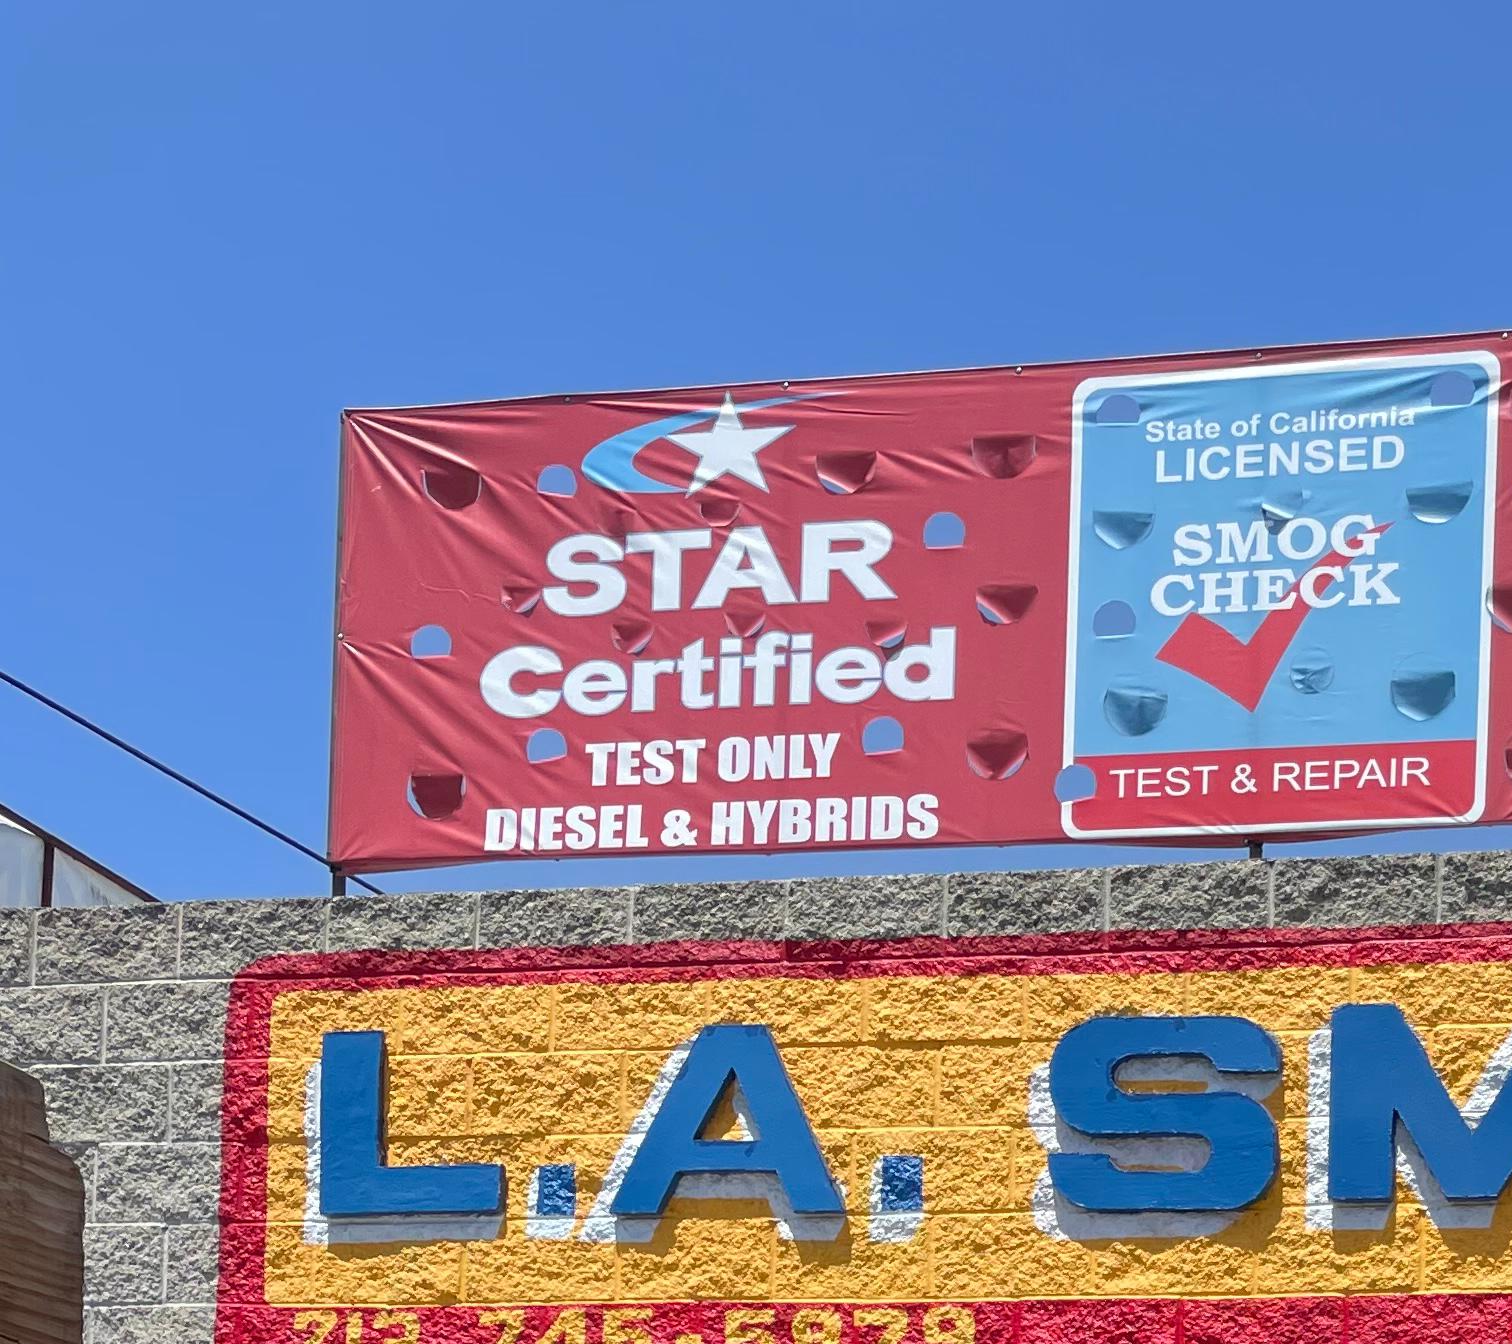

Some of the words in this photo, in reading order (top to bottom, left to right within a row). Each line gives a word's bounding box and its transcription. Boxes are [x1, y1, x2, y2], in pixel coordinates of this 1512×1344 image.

[1144, 418, 1220, 444] State
[1230, 412, 1261, 437] of
[1269, 406, 1416, 435] California
[1155, 435, 1406, 484] LICENSED
[541, 519, 898, 618] STAR
[1173, 513, 1382, 568] SMOG
[1150, 561, 1401, 617] CHECK
[479, 625, 958, 720] Certified
[584, 738, 706, 787] TEST
[717, 731, 842, 782] ONLY
[1109, 764, 1219, 799] TEST
[1230, 763, 1258, 795] &
[1273, 757, 1432, 792] REPAIR
[483, 804, 650, 853] DIESEL
[659, 808, 699, 848] &
[710, 792, 940, 845] HYBRIDS
[312, 1022, 927, 1224] L.A.
